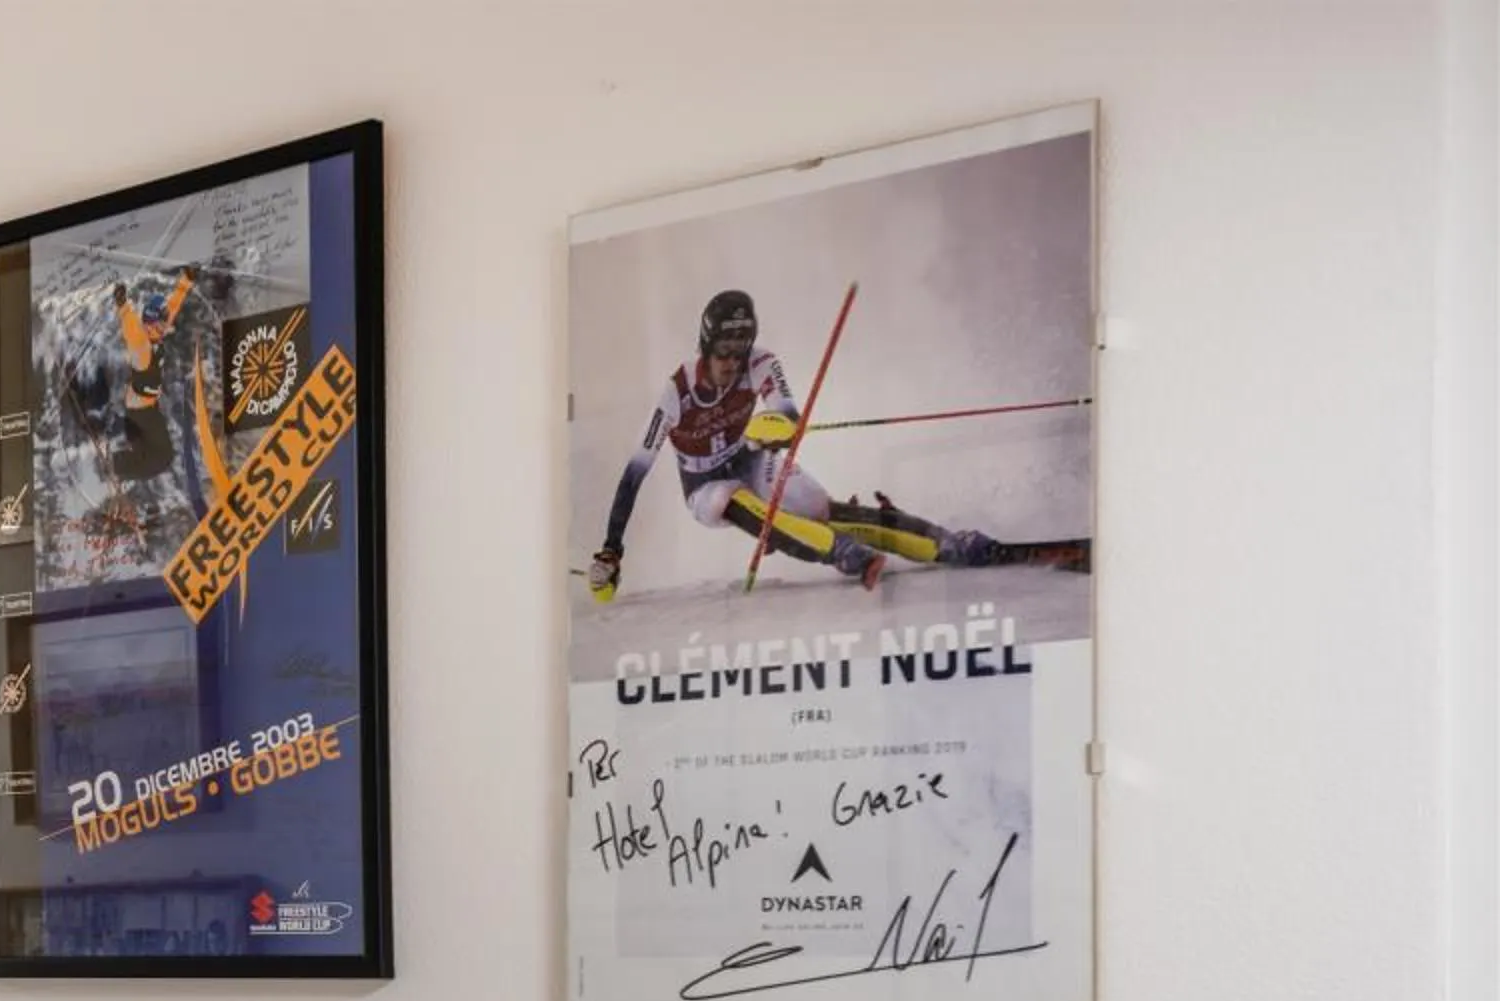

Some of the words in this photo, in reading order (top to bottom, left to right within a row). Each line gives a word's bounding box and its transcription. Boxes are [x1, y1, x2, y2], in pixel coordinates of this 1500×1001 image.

[229, 325, 277, 397] MADONNA
[169, 353, 352, 600] FREESTYLE
[189, 478, 293, 610] WORLD
[615, 631, 862, 706] CLÉMENT
[880, 601, 1033, 687] NOËL
[791, 708, 832, 726] (FRA)
[793, 748, 837, 762] WORLD
[841, 746, 867, 760] CUP
[872, 743, 929, 757] RANKING
[68, 771, 122, 826] 20
[135, 740, 243, 801] DICEMBRE
[251, 712, 315, 756] 2003
[74, 783, 198, 855] MOGULS
[230, 726, 342, 794] GOBBE
[592, 779, 670, 873] Hotel
[832, 773, 949, 826] Grazie
[278, 905, 329, 918] FREESTYLE
[279, 918, 311, 932] WORLD
[312, 918, 332, 932] CUP
[760, 895, 863, 913] DYNASTAR
